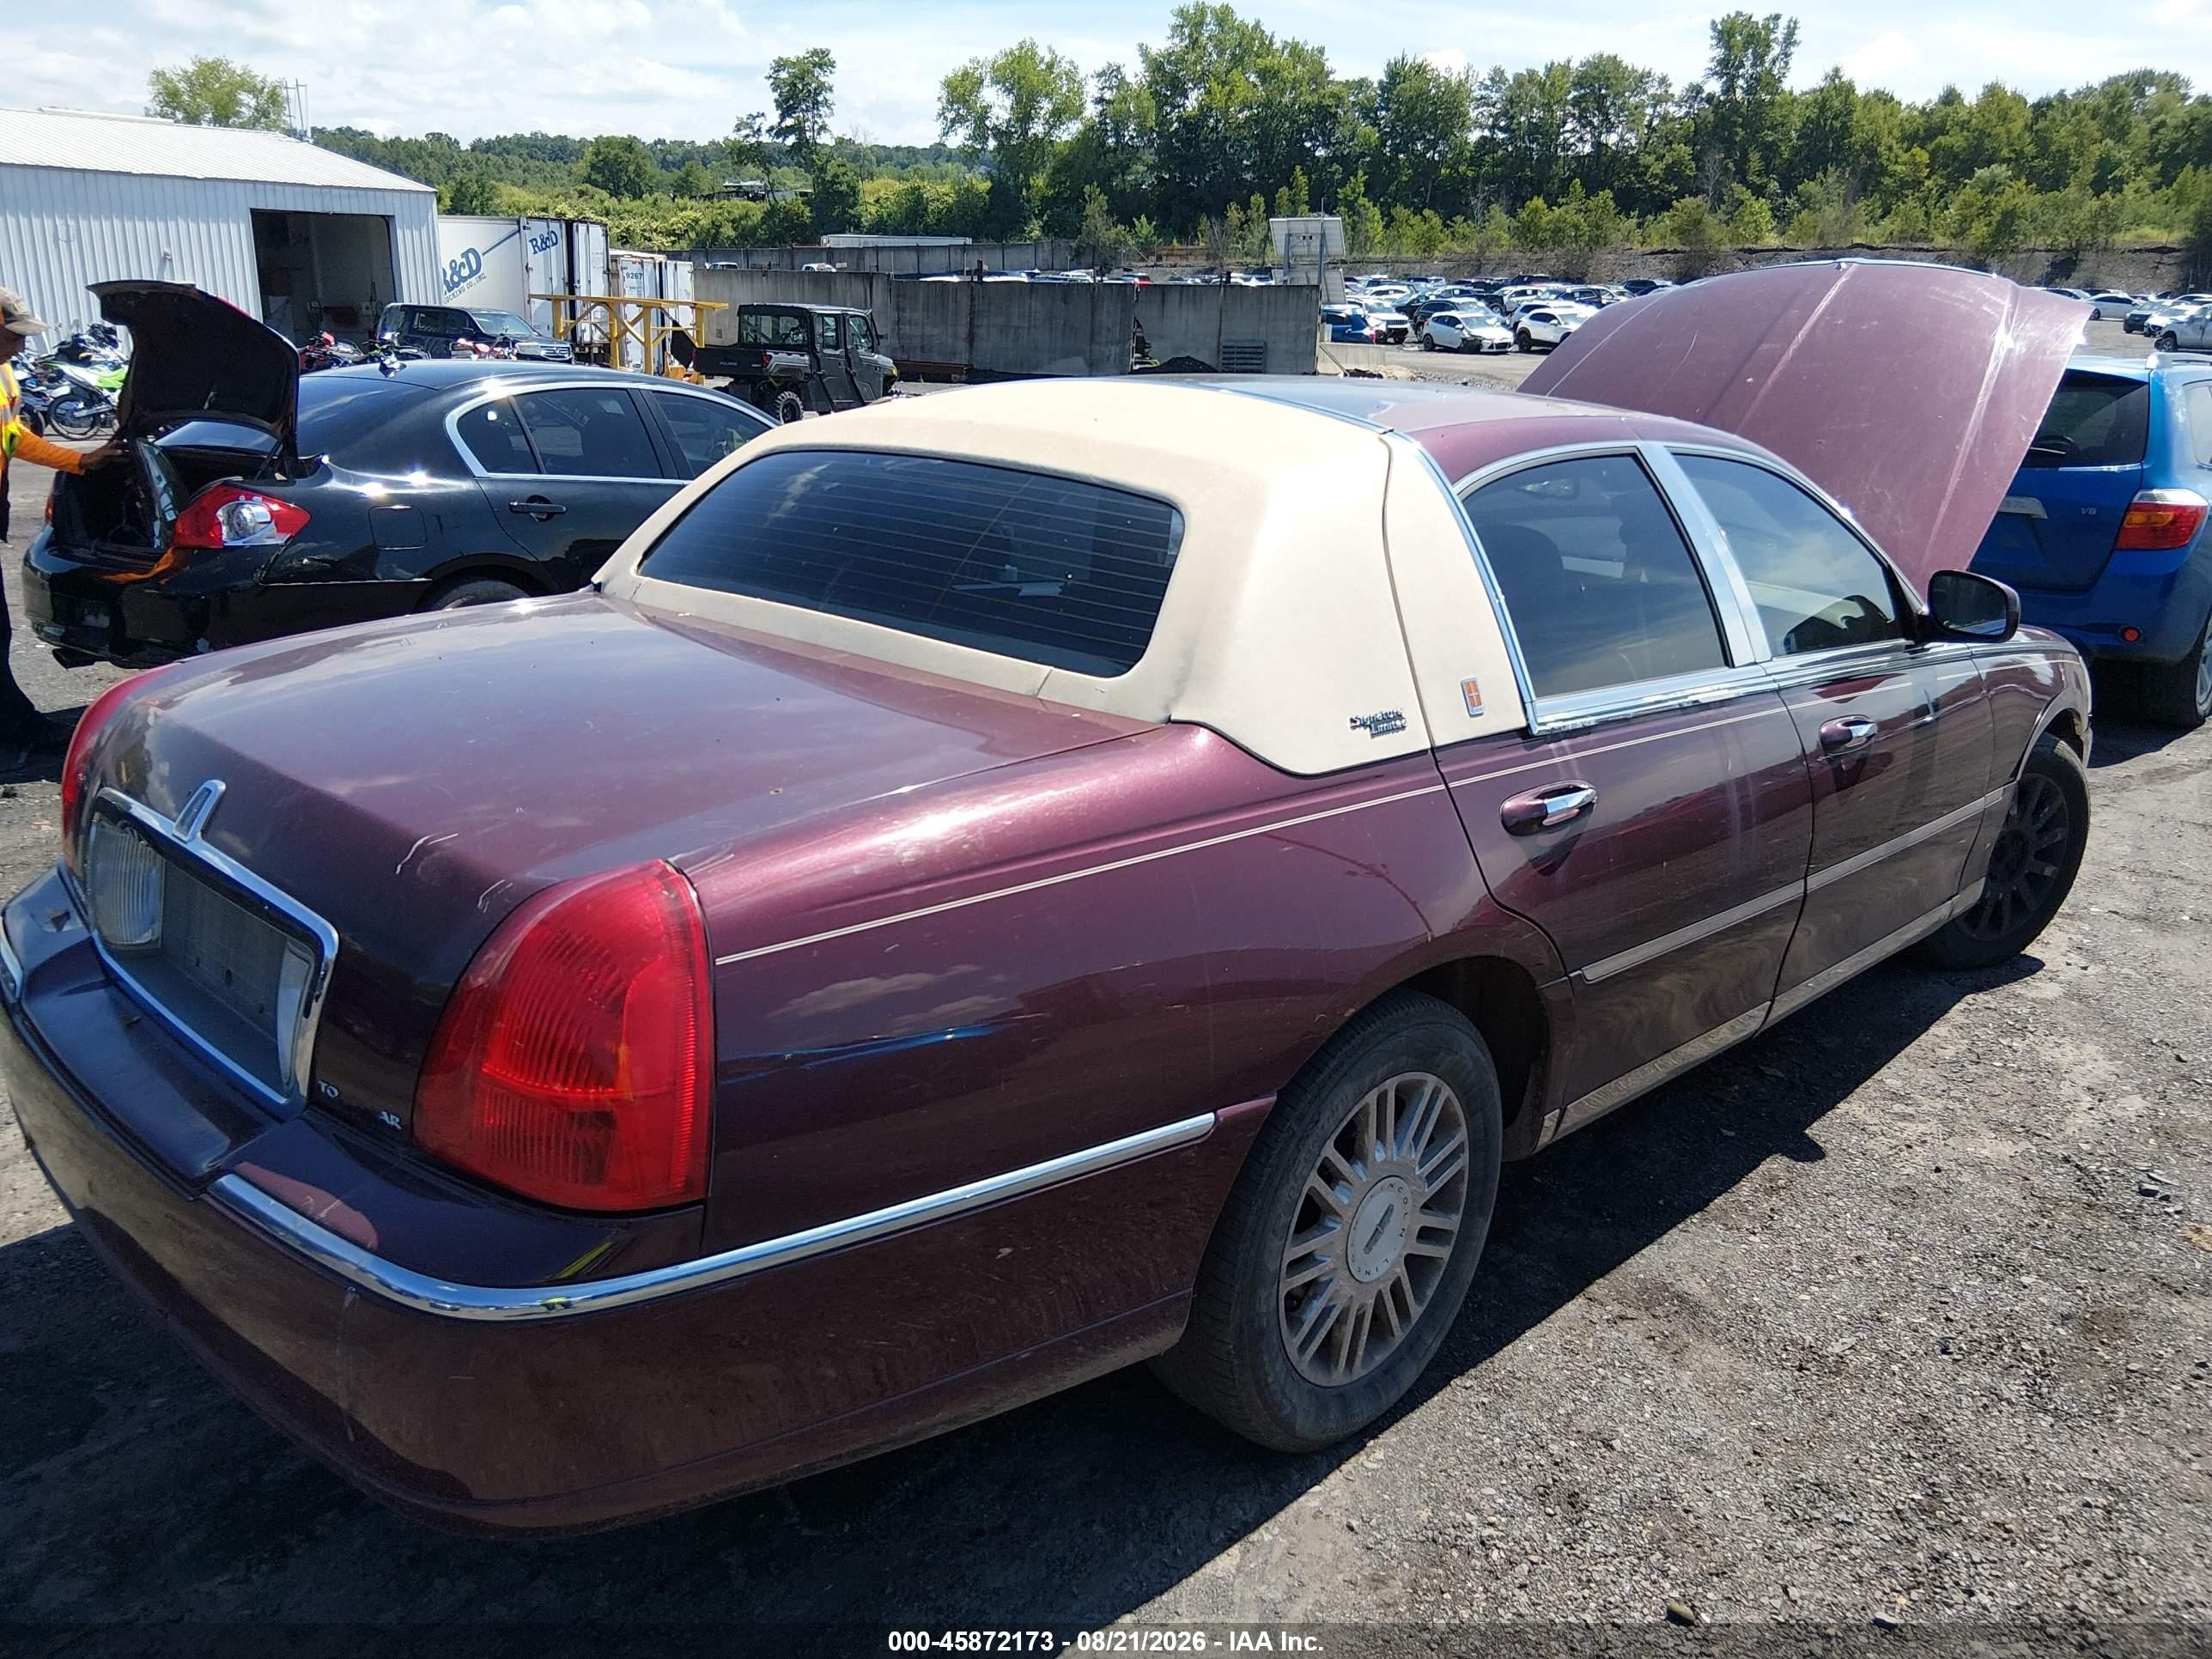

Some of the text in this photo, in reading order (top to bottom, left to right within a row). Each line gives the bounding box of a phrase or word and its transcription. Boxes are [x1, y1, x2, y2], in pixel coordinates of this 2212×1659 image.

[529, 230, 558, 254] R&D
[446, 286, 465, 303] UCKING
[1350, 708, 1404, 728] Signature
[1370, 718, 1408, 736] Limited
[318, 1080, 402, 1130] TO AR
